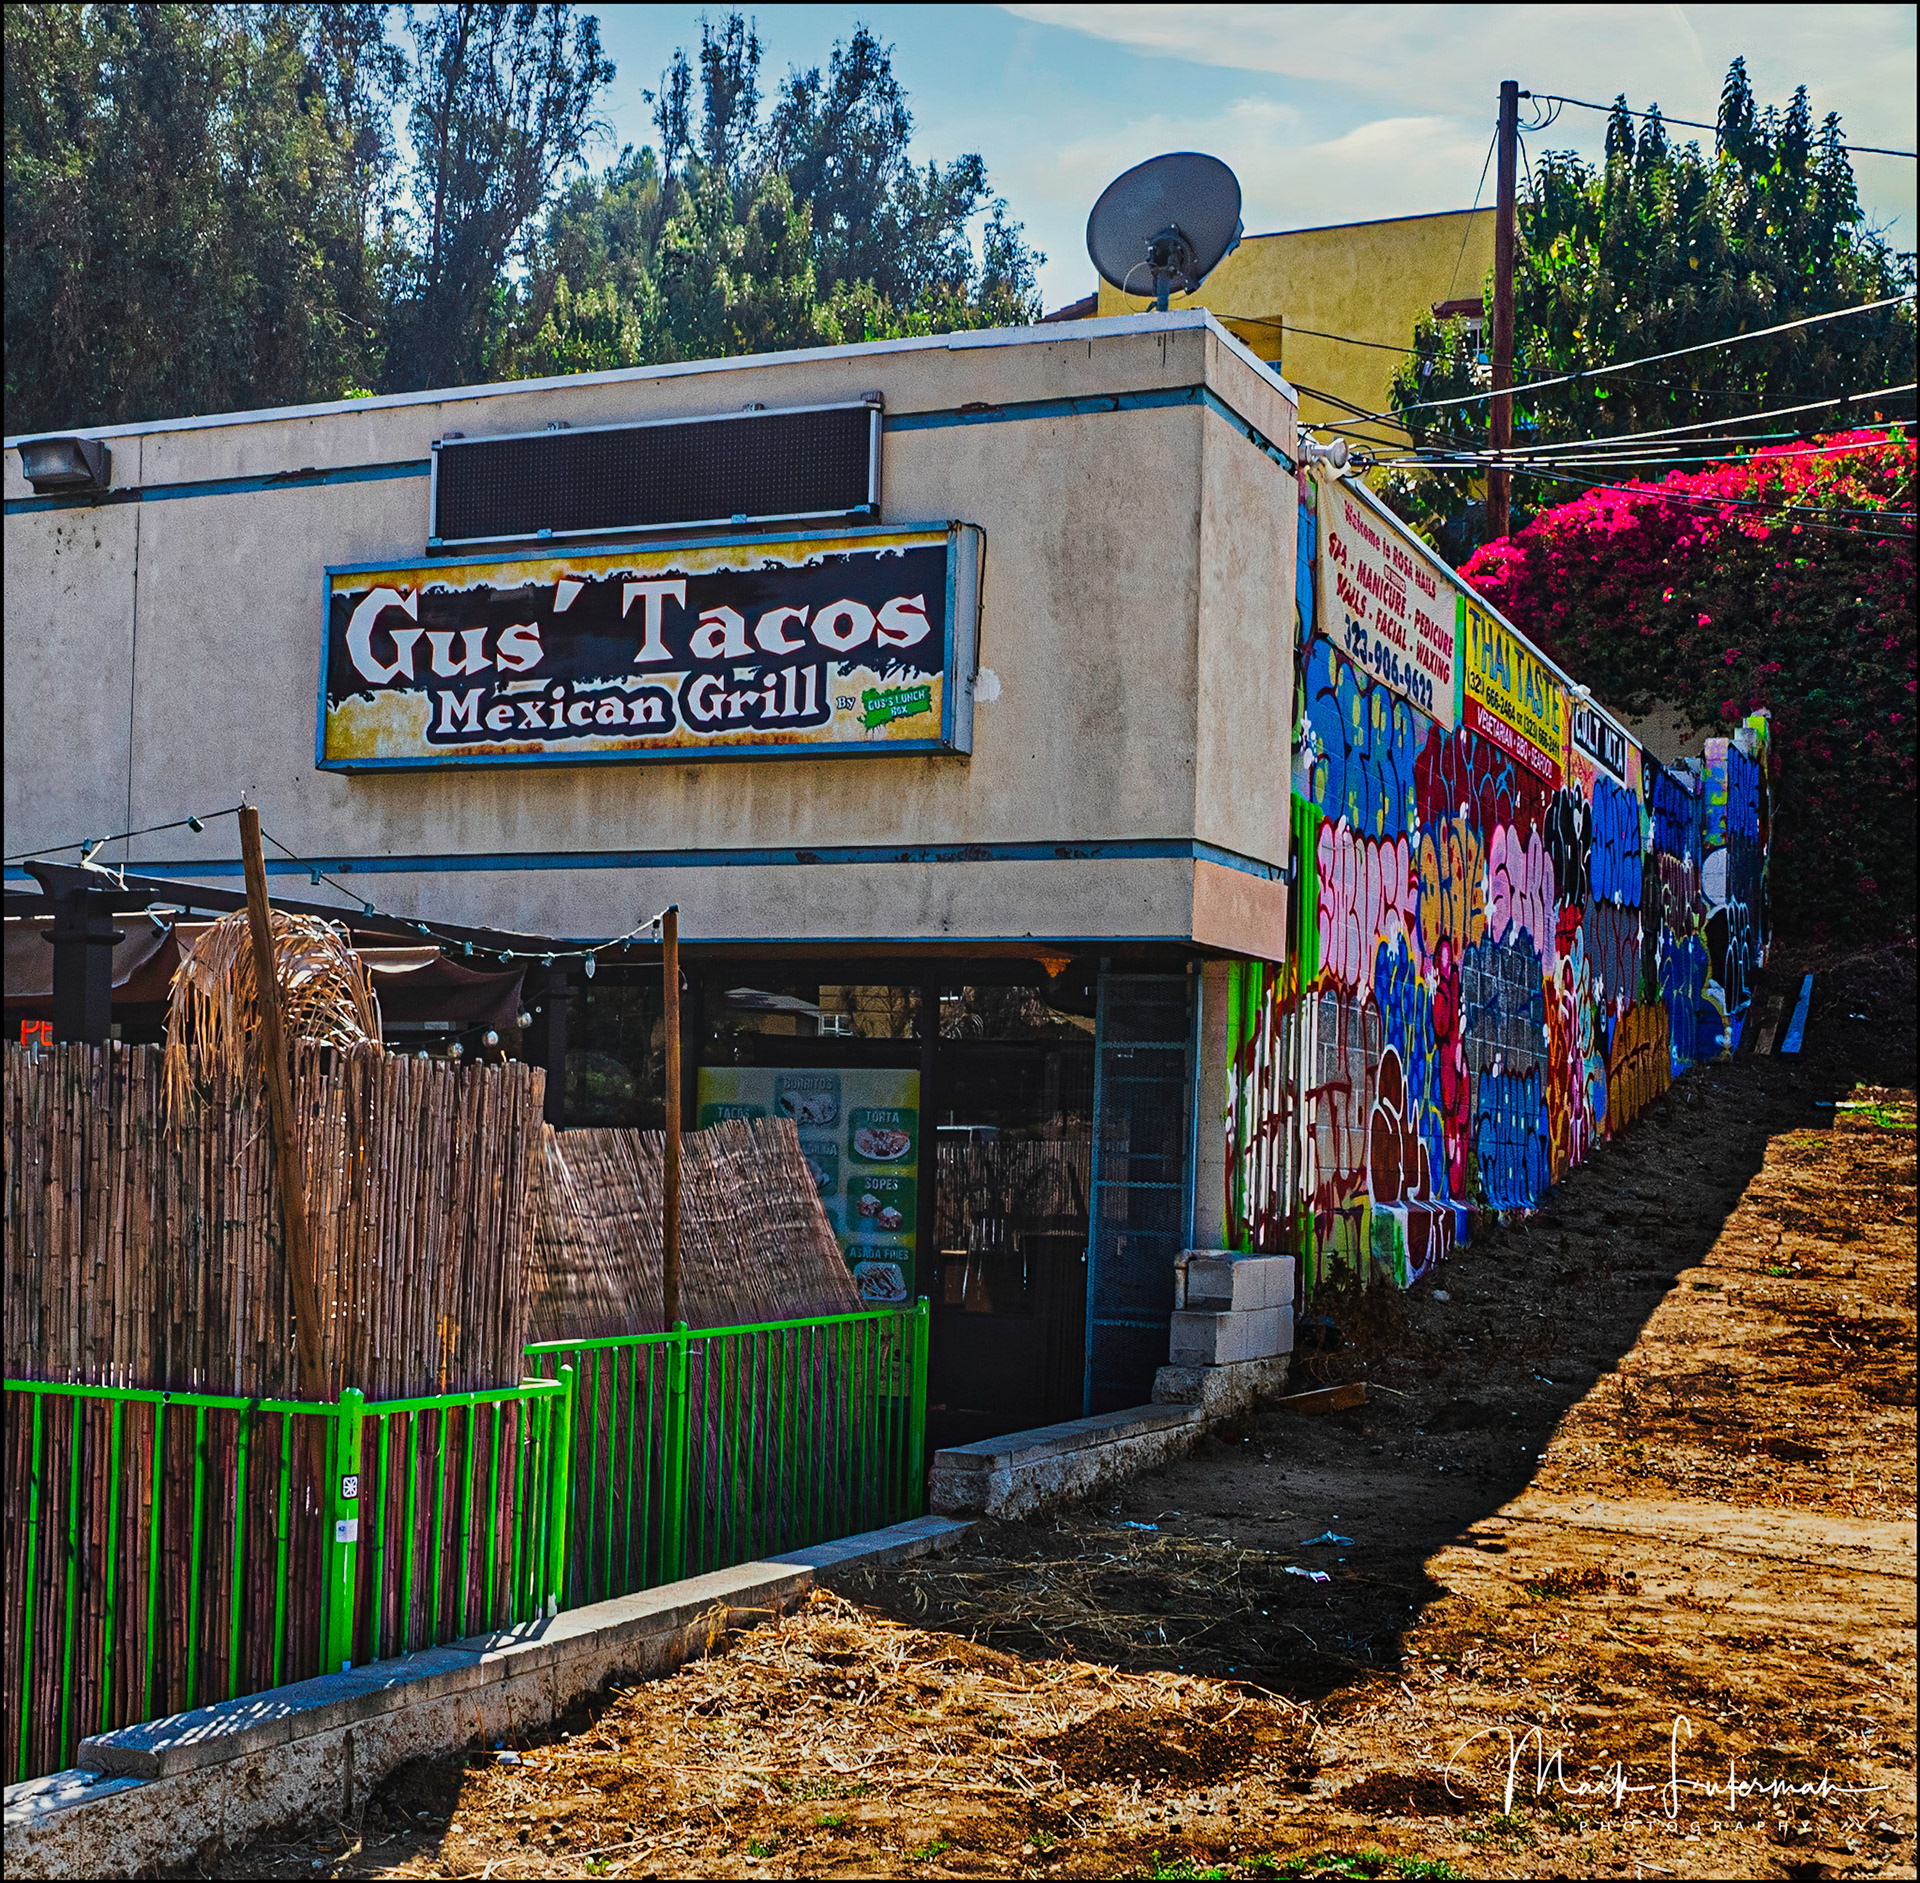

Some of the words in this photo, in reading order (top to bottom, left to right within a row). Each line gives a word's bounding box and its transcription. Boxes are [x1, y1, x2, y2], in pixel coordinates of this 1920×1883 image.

[1343, 499, 1380, 551] Welcome
[622, 579, 931, 662] Tacos
[1356, 559, 1407, 619] MANICURE
[1414, 608, 1454, 659] PEDICURE
[1343, 613, 1433, 711] 323-906-9622
[1375, 608, 1407, 651] FACIAL
[1416, 640, 1451, 684] WAXING
[1469, 607, 1510, 693] THAI
[1514, 645, 1560, 735] TASTE
[435, 685, 667, 735] Mexican
[687, 664, 820, 722] Grill
[836, 695, 856, 711] By
[895, 689, 925, 704] LUNCH
[783, 1077, 833, 1090] BURRITOS
[717, 1106, 750, 1119] TACOS
[865, 1110, 899, 1123] TORTA
[864, 1177, 899, 1191] SOPES
[849, 1247, 881, 1260] ASADA
[884, 1248, 909, 1260] FRIES
